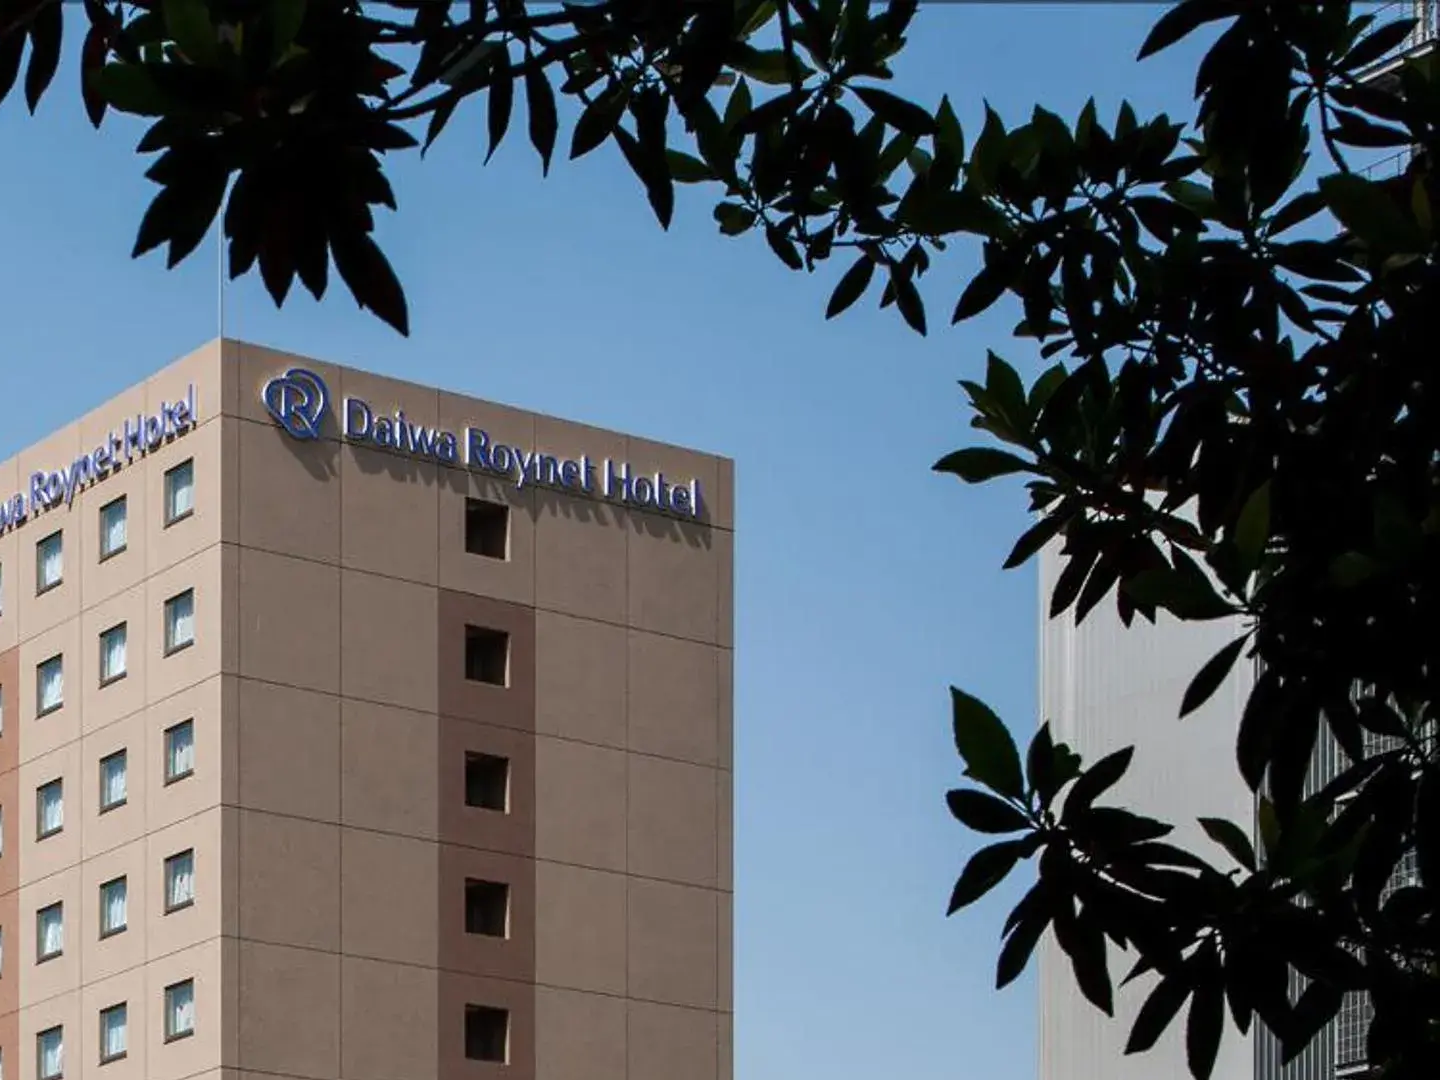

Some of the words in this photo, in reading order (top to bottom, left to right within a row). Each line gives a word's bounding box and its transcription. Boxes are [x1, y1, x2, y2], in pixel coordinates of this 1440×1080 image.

[29, 432, 121, 510] Roynet
[123, 384, 198, 464] Hotel
[343, 398, 458, 463] Daiwa
[464, 426, 594, 488] Roynet
[603, 463, 701, 518] Hotel
